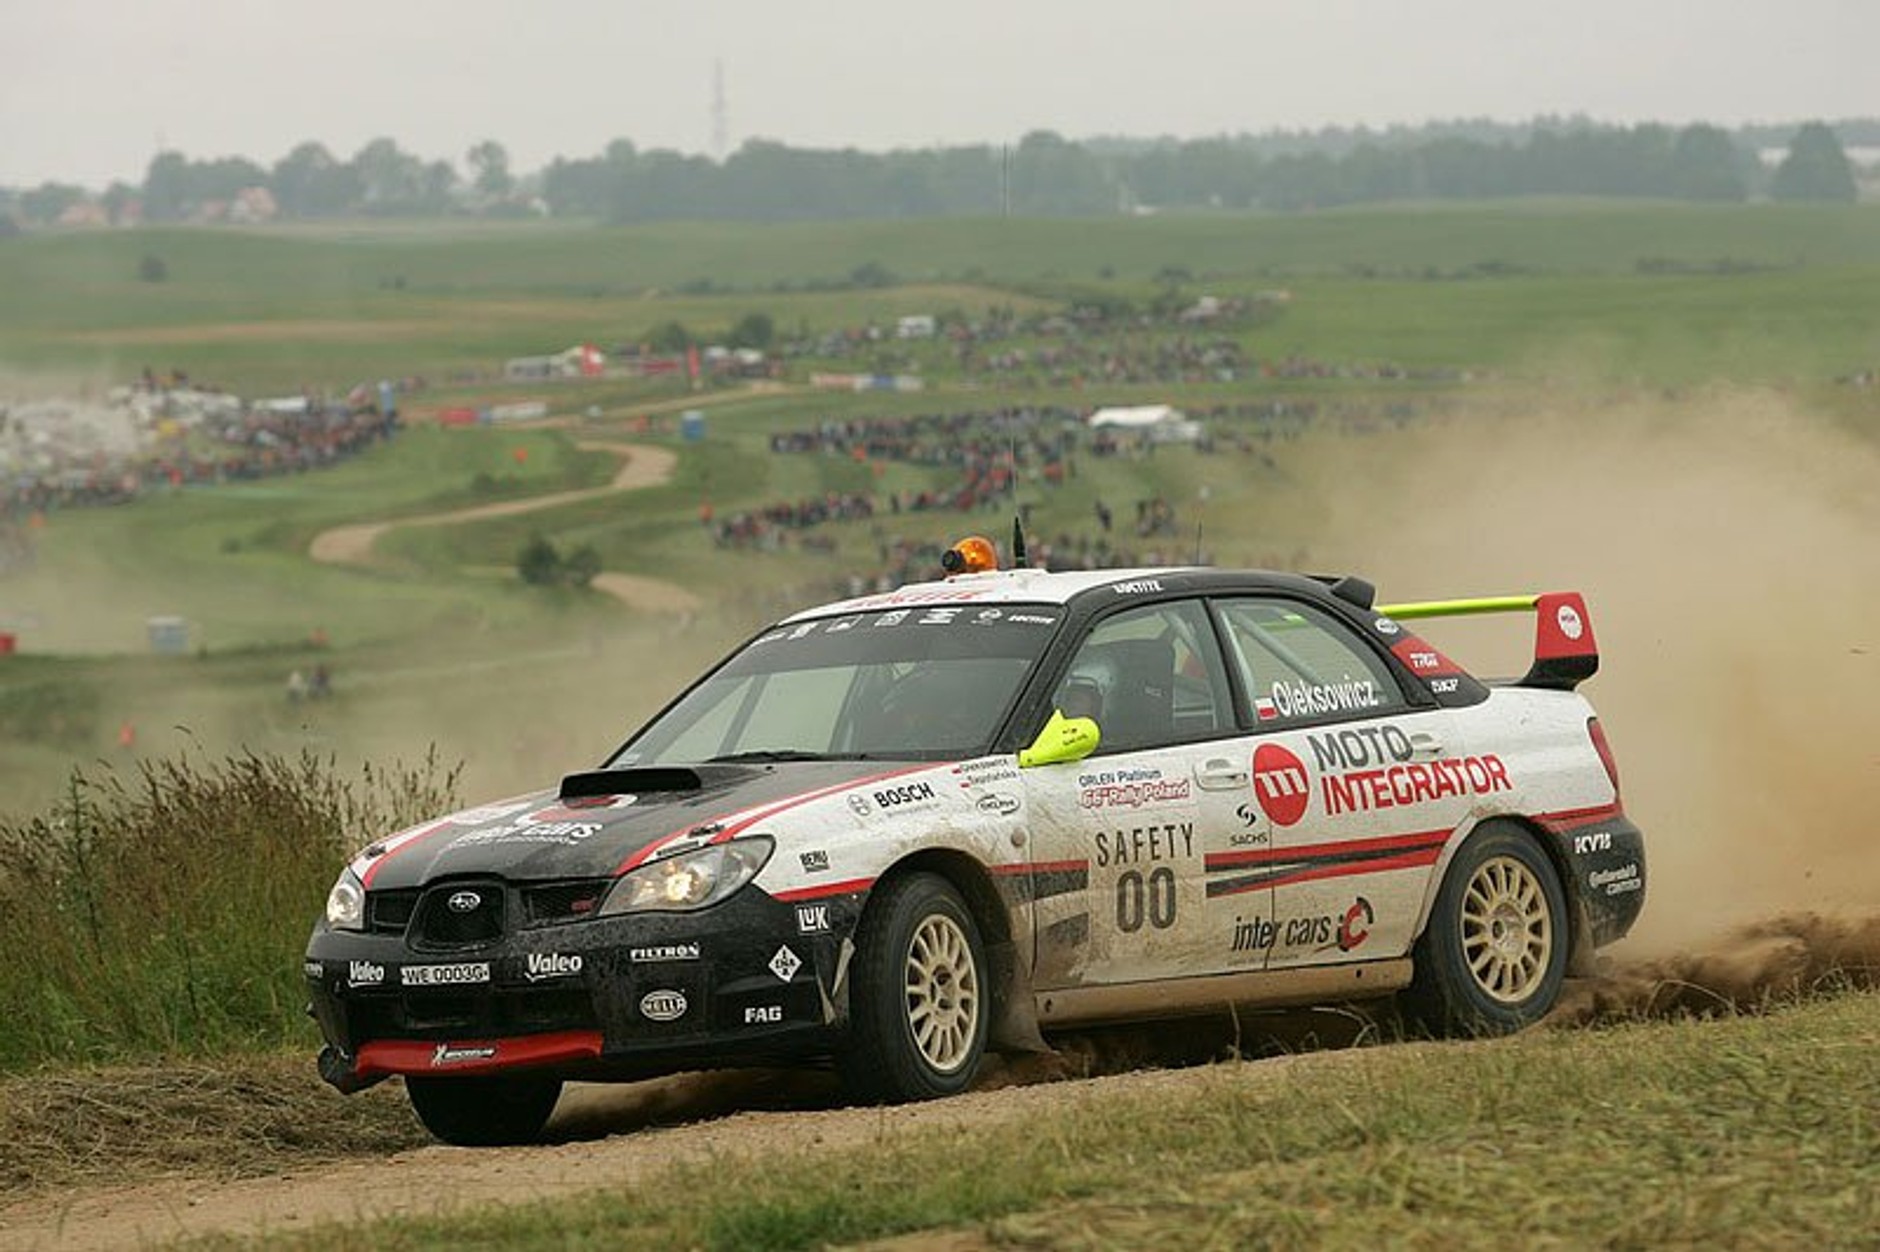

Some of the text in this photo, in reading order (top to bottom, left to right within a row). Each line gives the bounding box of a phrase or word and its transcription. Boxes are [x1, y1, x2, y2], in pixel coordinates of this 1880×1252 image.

[1112, 580, 1164, 594] LOCTITE
[1272, 675, 1379, 717] Oleksowicz
[1307, 726, 1413, 771] MOTO
[1079, 769, 1162, 787] ORLEN Platinum
[1321, 754, 1513, 815] INTEGRATOR
[874, 782, 935, 808] BOSCH
[1108, 784, 1141, 807] Rally
[1143, 779, 1189, 802] Poland
[1095, 823, 1193, 867] SAFETY
[1230, 832, 1268, 846] SACHS
[1574, 832, 1611, 854] KYB
[1116, 867, 1176, 933] 00
[1231, 916, 1331, 950] inter cars
[350, 961, 385, 981] Valeo
[528, 953, 582, 973] Valeo
[744, 1006, 782, 1023] FAG
